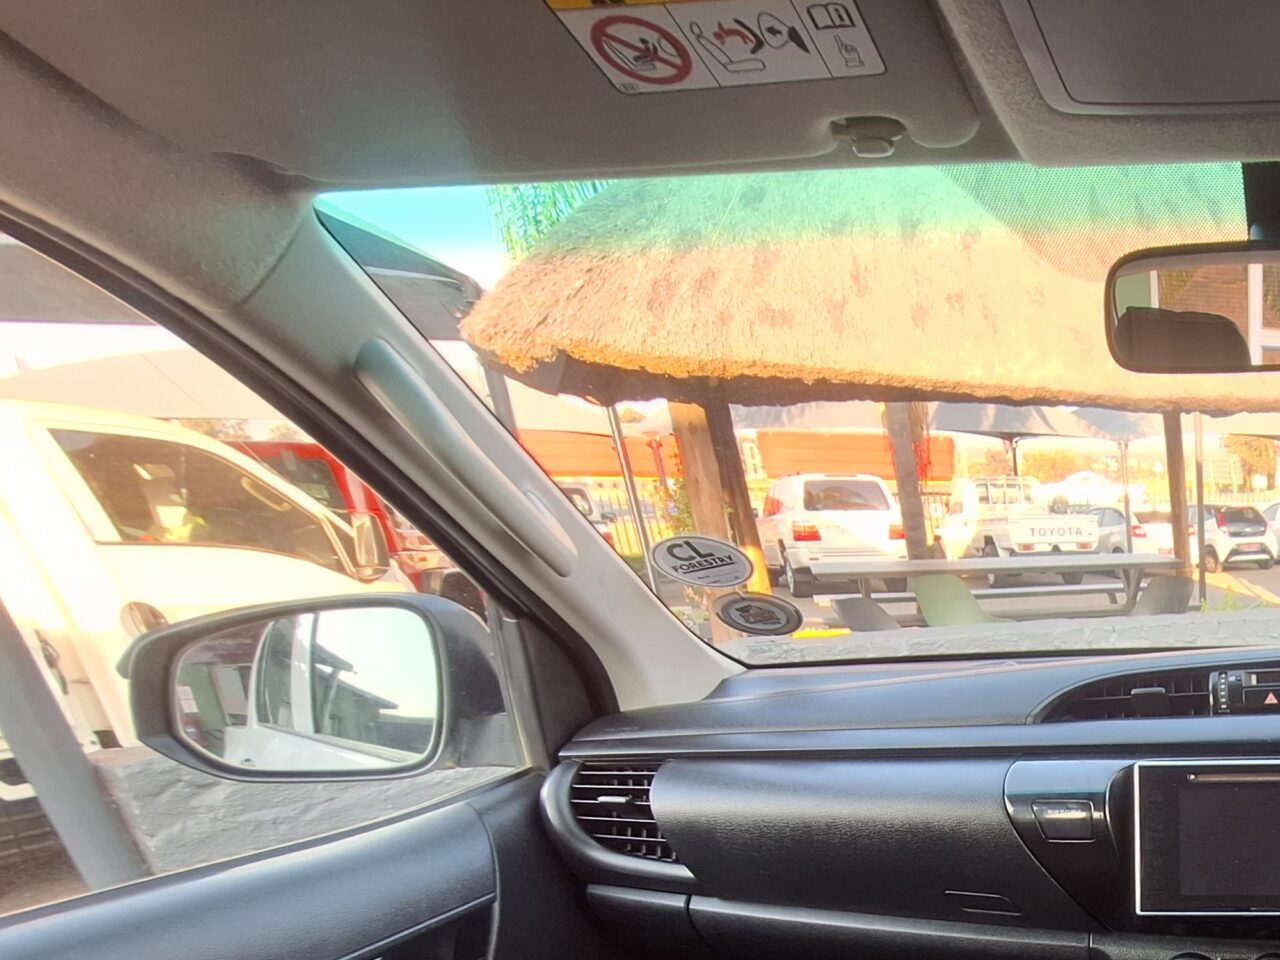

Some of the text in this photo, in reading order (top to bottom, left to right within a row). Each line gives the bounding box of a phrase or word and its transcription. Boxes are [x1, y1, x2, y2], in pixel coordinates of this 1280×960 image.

[1029, 527, 1083, 537] TOYOTA
[666, 540, 714, 562] CL
[671, 555, 734, 573] FORESTRY
